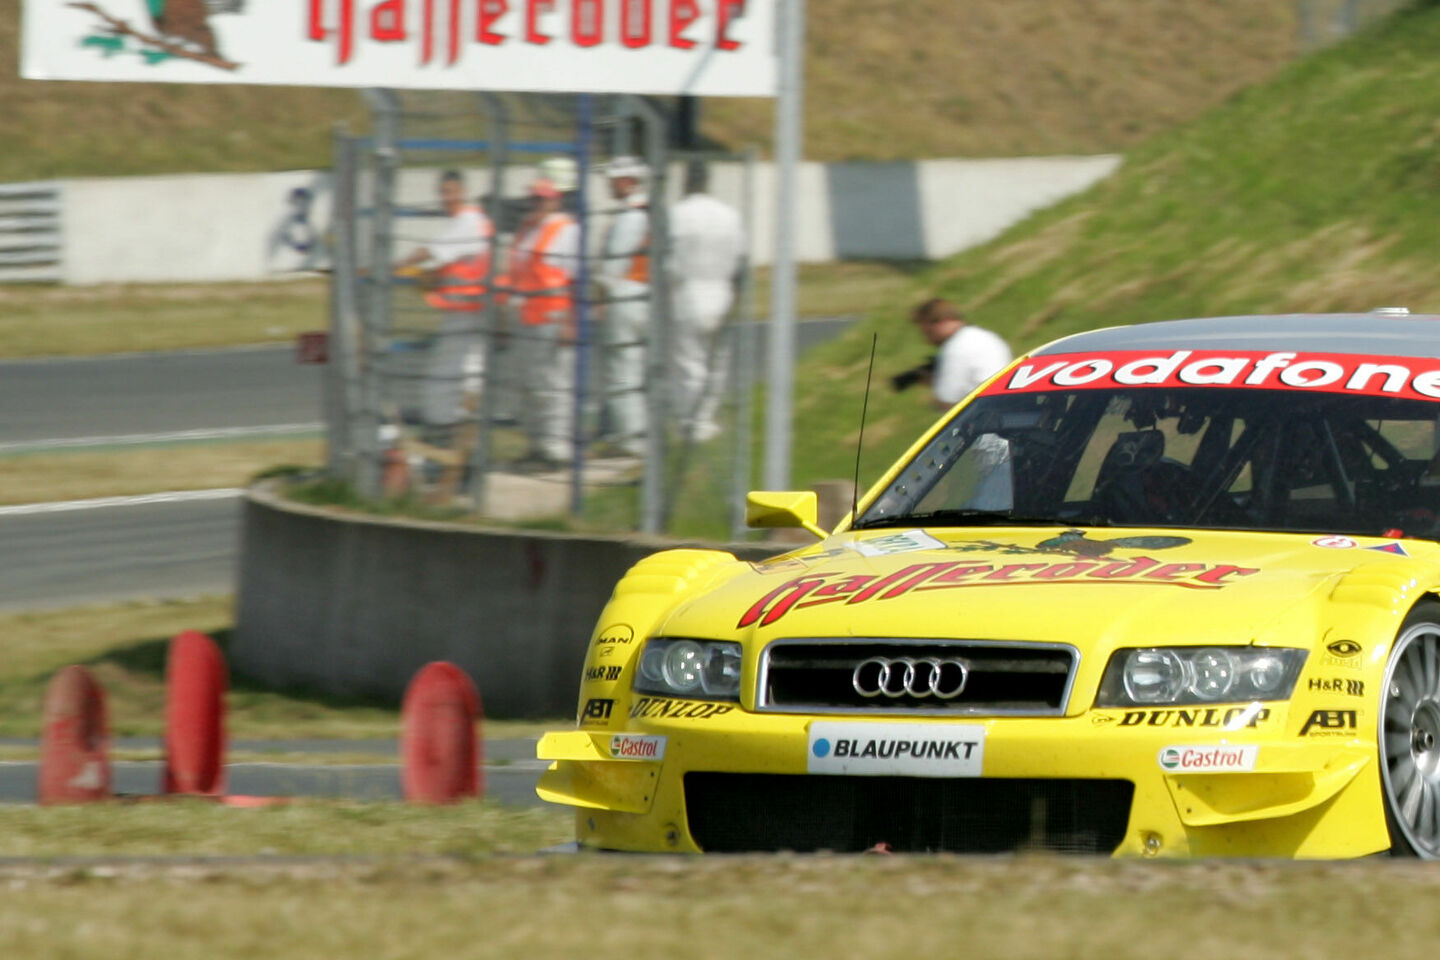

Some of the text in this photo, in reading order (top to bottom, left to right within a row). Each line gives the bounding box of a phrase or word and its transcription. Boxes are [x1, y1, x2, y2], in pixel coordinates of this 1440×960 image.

[1308, 678, 1343, 692] H&R
[578, 698, 615, 728] ABT
[629, 697, 734, 719] DUNLOP
[1116, 707, 1271, 729] DUNLOP
[1298, 709, 1357, 737] ABT
[619, 737, 659, 757] Castrol
[833, 739, 978, 760] BLAUPUNKT
[1181, 748, 1244, 768] Castrol
